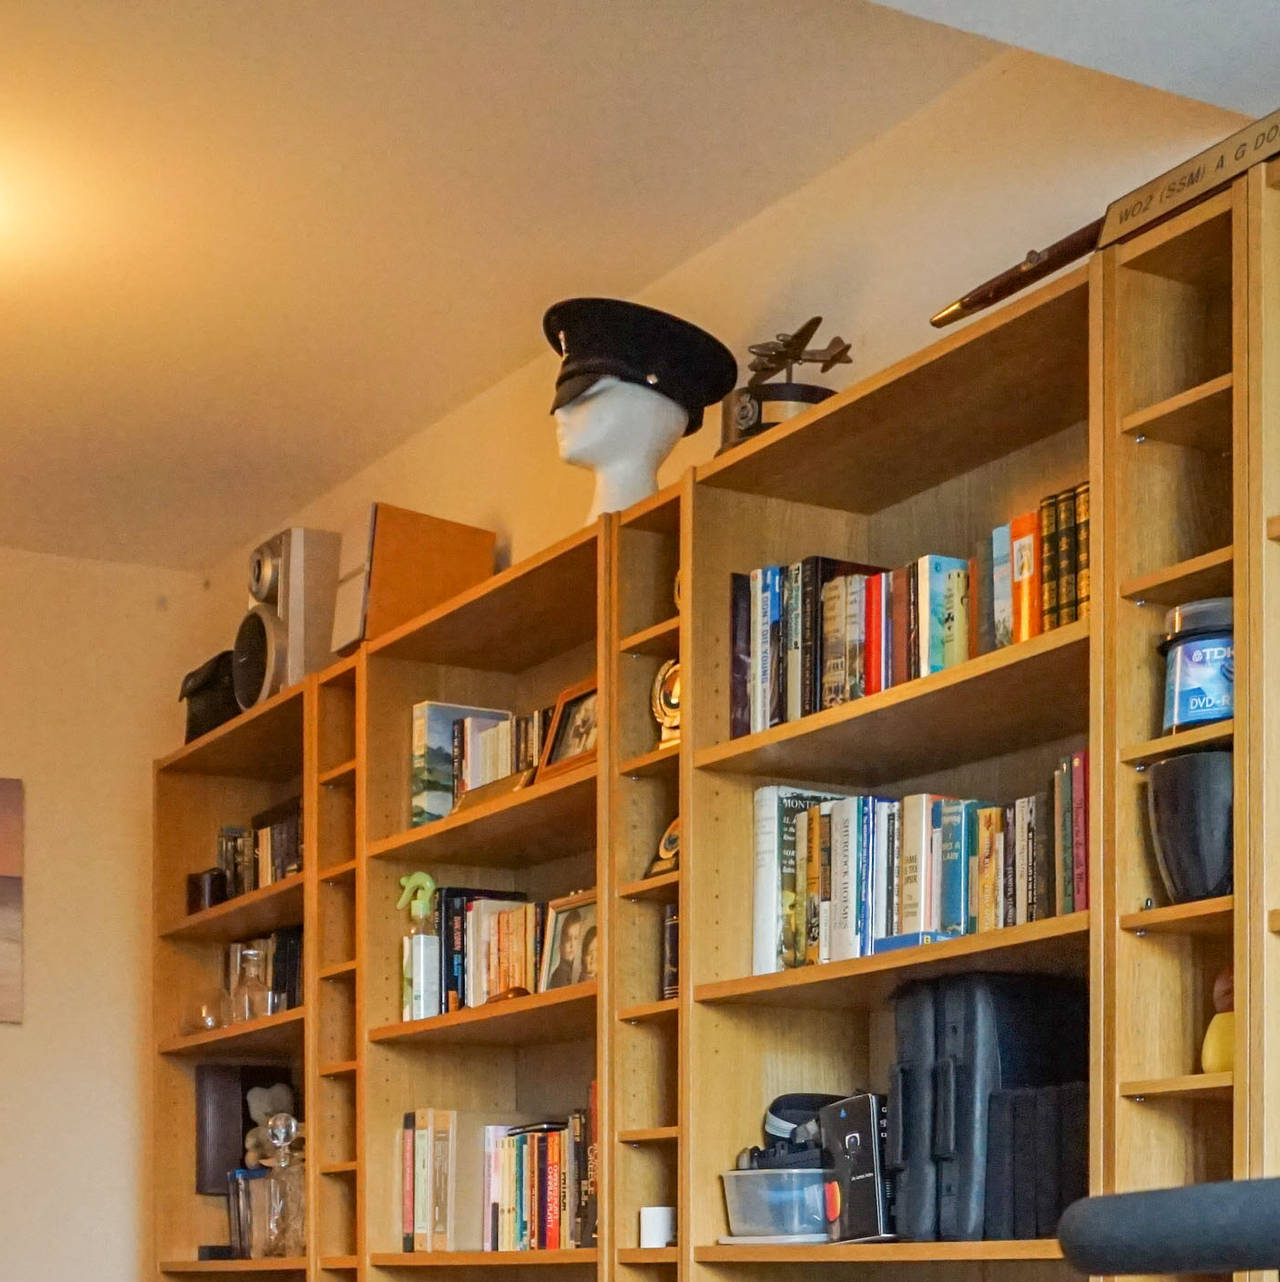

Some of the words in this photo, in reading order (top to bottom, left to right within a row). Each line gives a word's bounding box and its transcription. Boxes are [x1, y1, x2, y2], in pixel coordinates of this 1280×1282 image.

[1119, 195, 1153, 225] WO2
[1216, 155, 1225, 171] A
[1234, 143, 1247, 162] G
[761, 629, 769, 645] DIE
[761, 650, 769, 684] YOUNG
[841, 818, 849, 880] SHERLOCK
[841, 881, 849, 929] HOLMES
